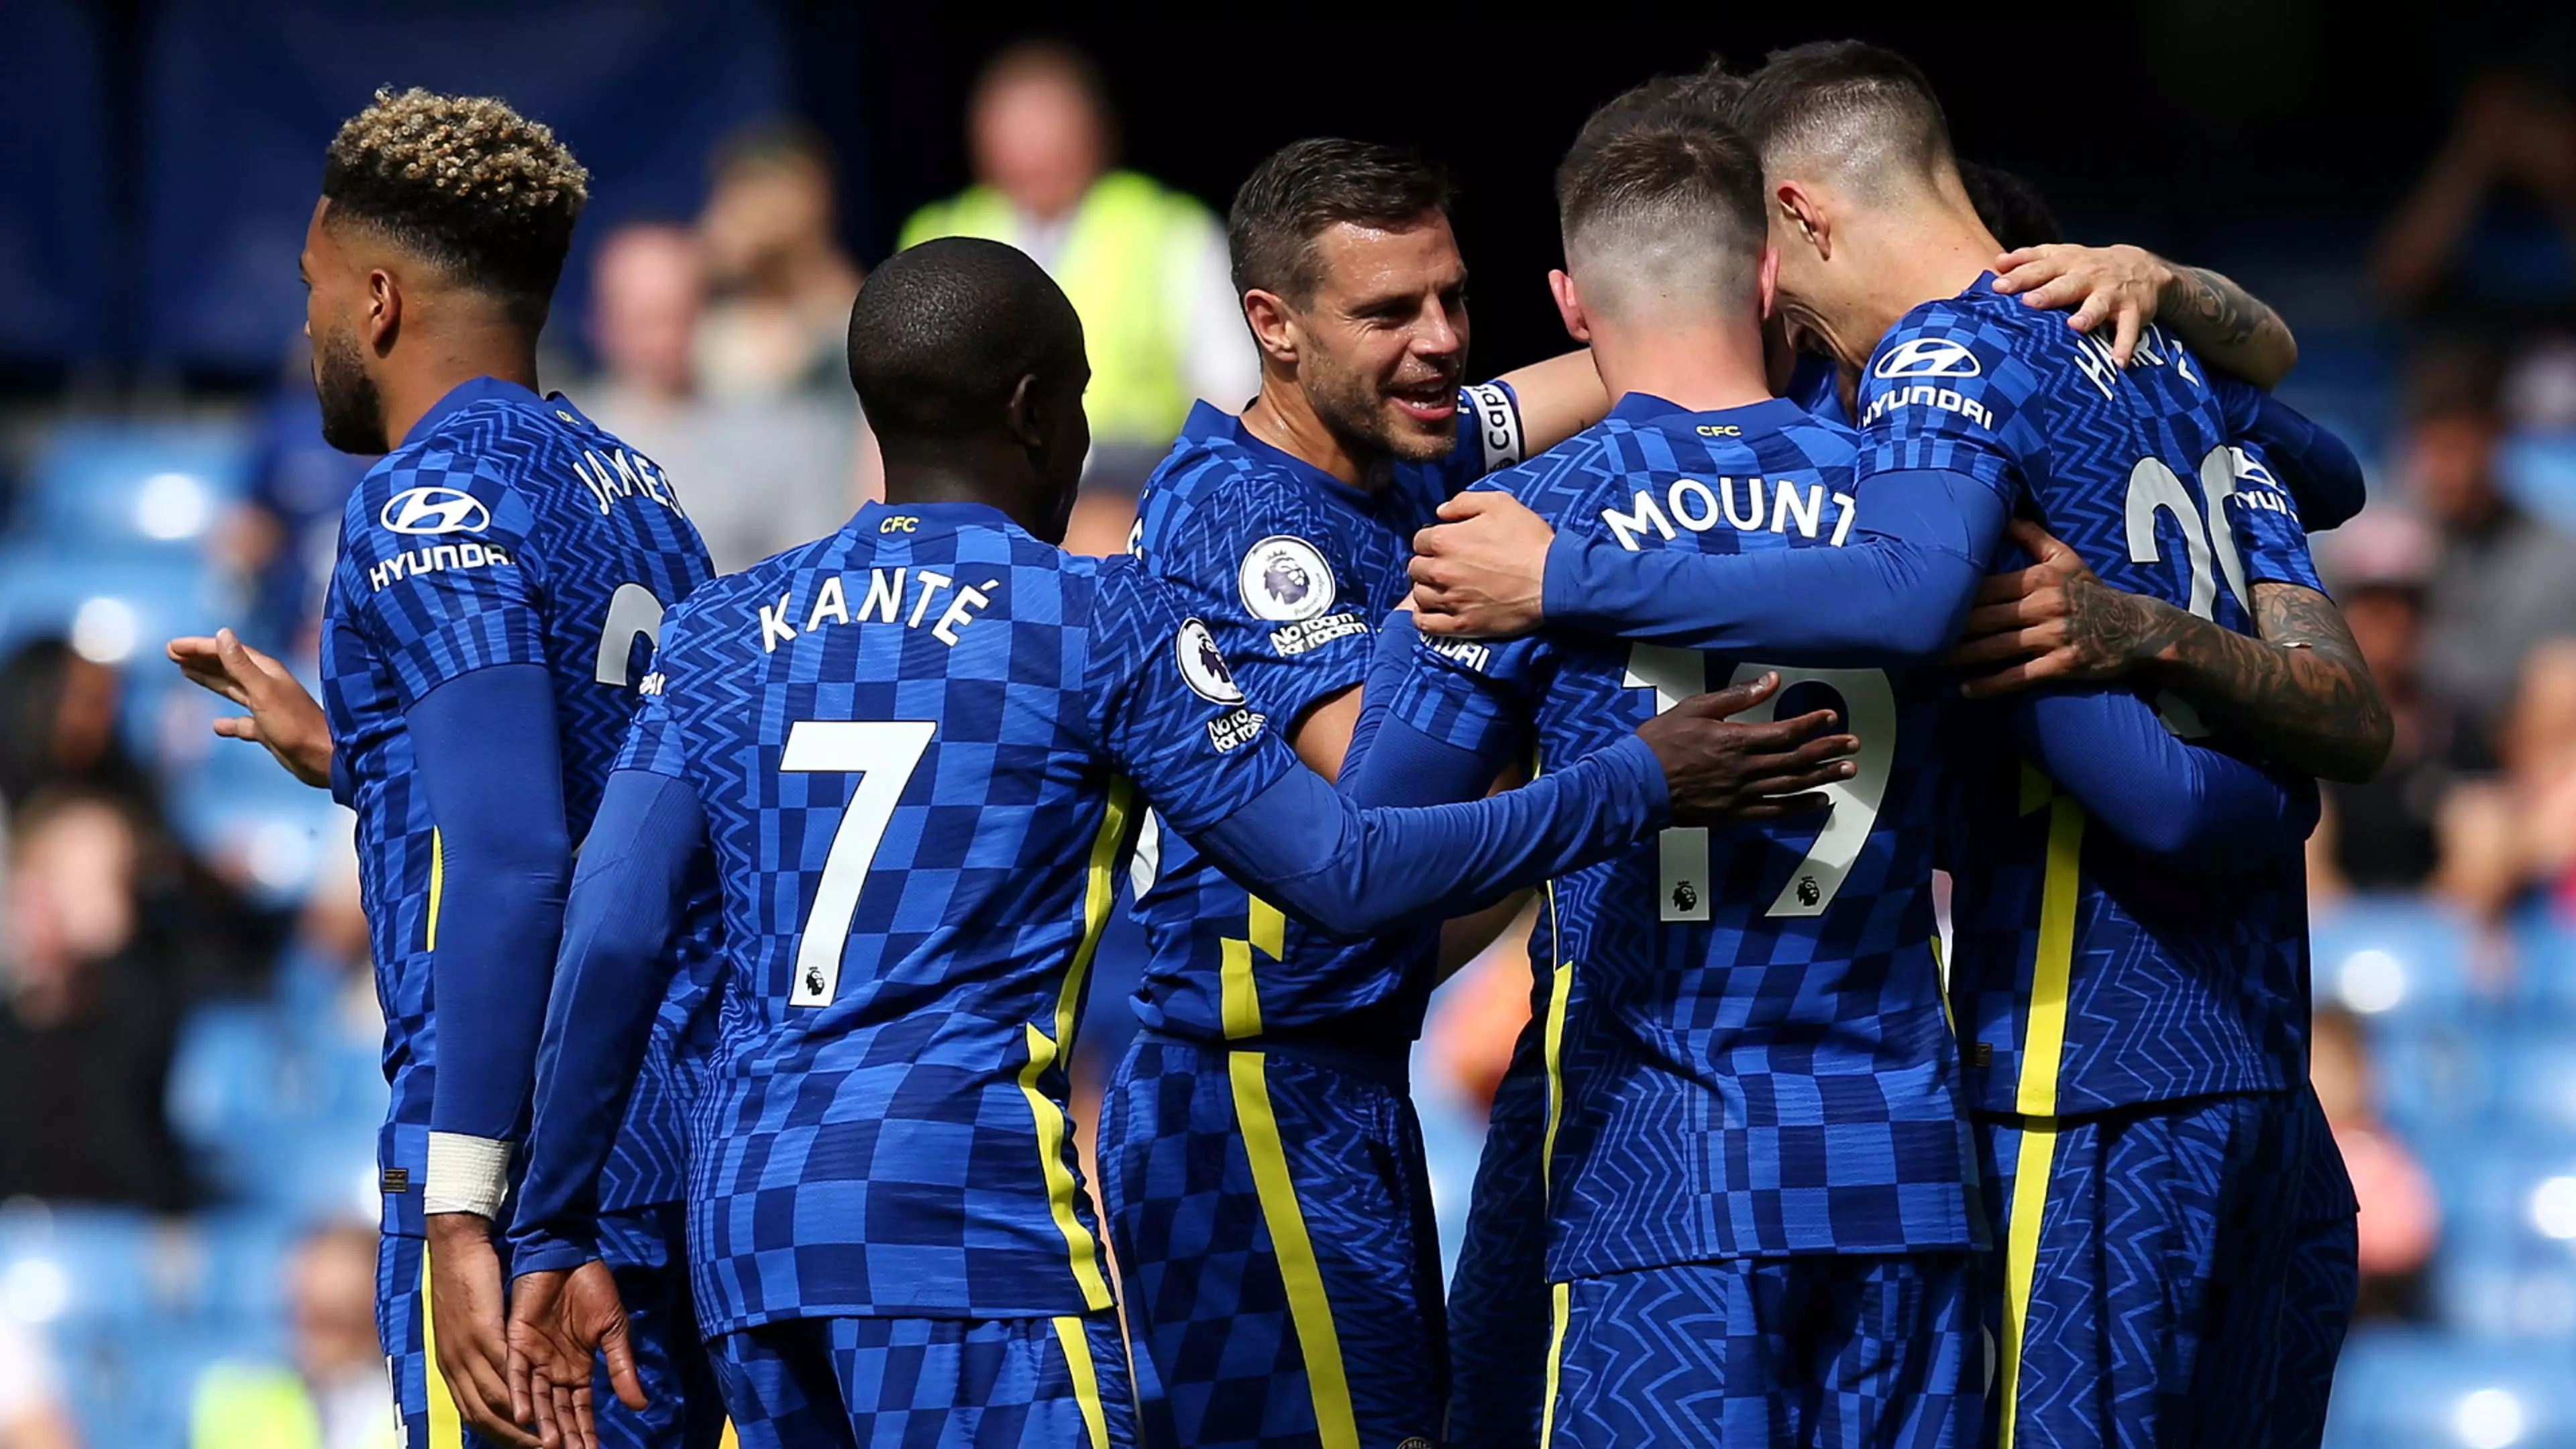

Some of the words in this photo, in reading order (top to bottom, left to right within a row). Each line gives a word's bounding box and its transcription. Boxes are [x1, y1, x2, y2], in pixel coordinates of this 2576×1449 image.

[1696, 425, 1741, 437] CFC
[879, 516, 920, 534] CFC
[759, 567, 1000, 655] KANTÉ
[1270, 625, 1302, 647] No
[1208, 718, 1231, 739] No
[779, 720, 937, 1006] 7
